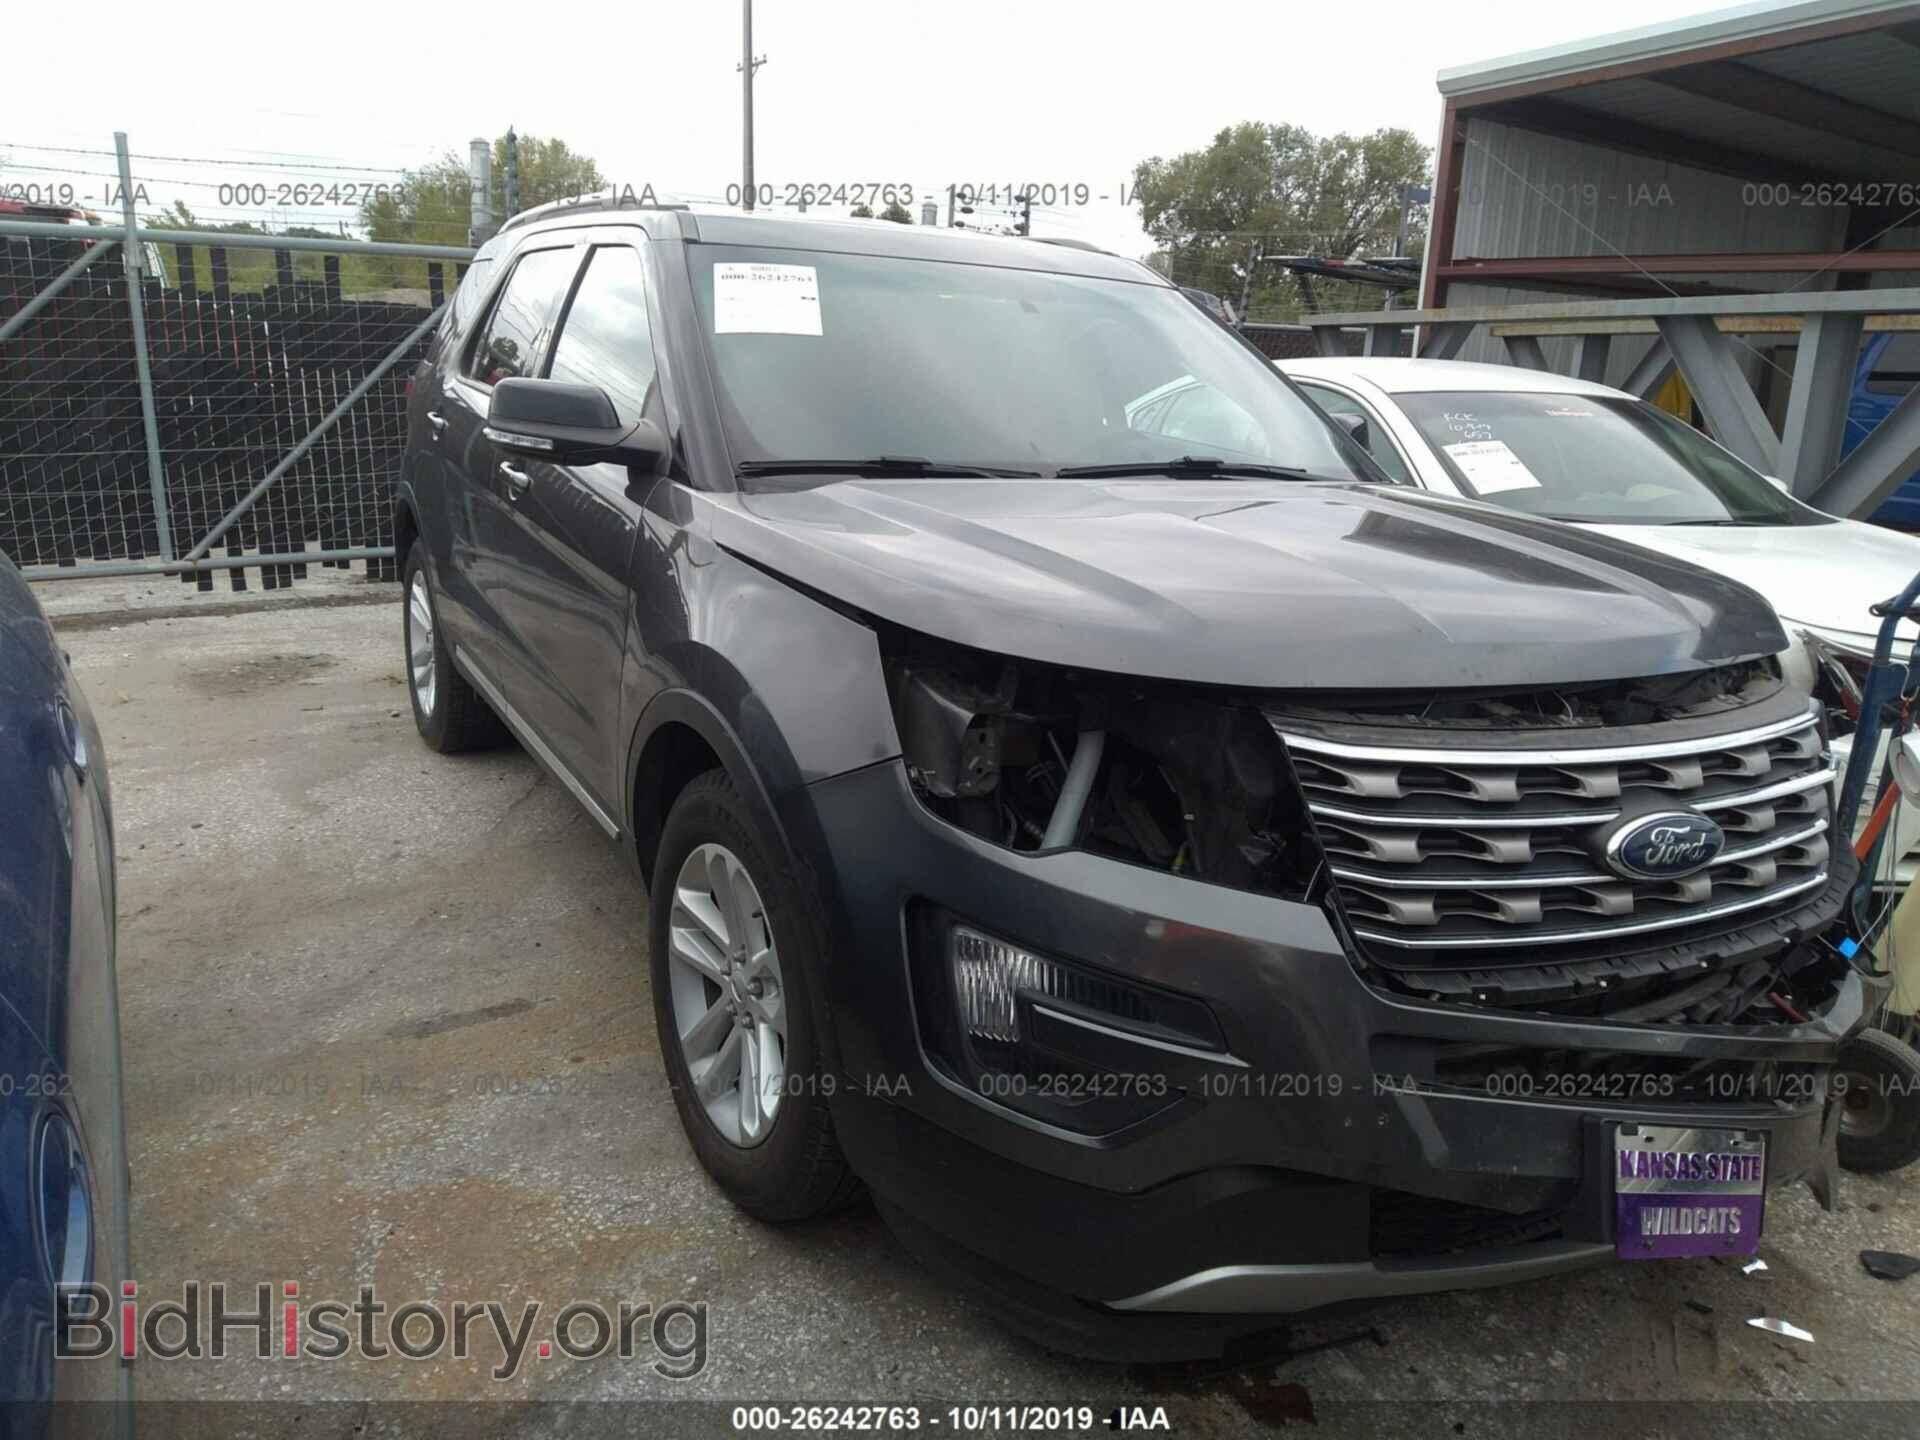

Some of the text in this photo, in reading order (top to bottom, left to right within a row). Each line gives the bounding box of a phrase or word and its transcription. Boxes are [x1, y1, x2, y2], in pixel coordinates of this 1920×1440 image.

[1645, 826, 1707, 865] Ford
[1619, 1150, 1762, 1181] KANSAS STATE
[1640, 1207, 1742, 1236] WILDCATS
